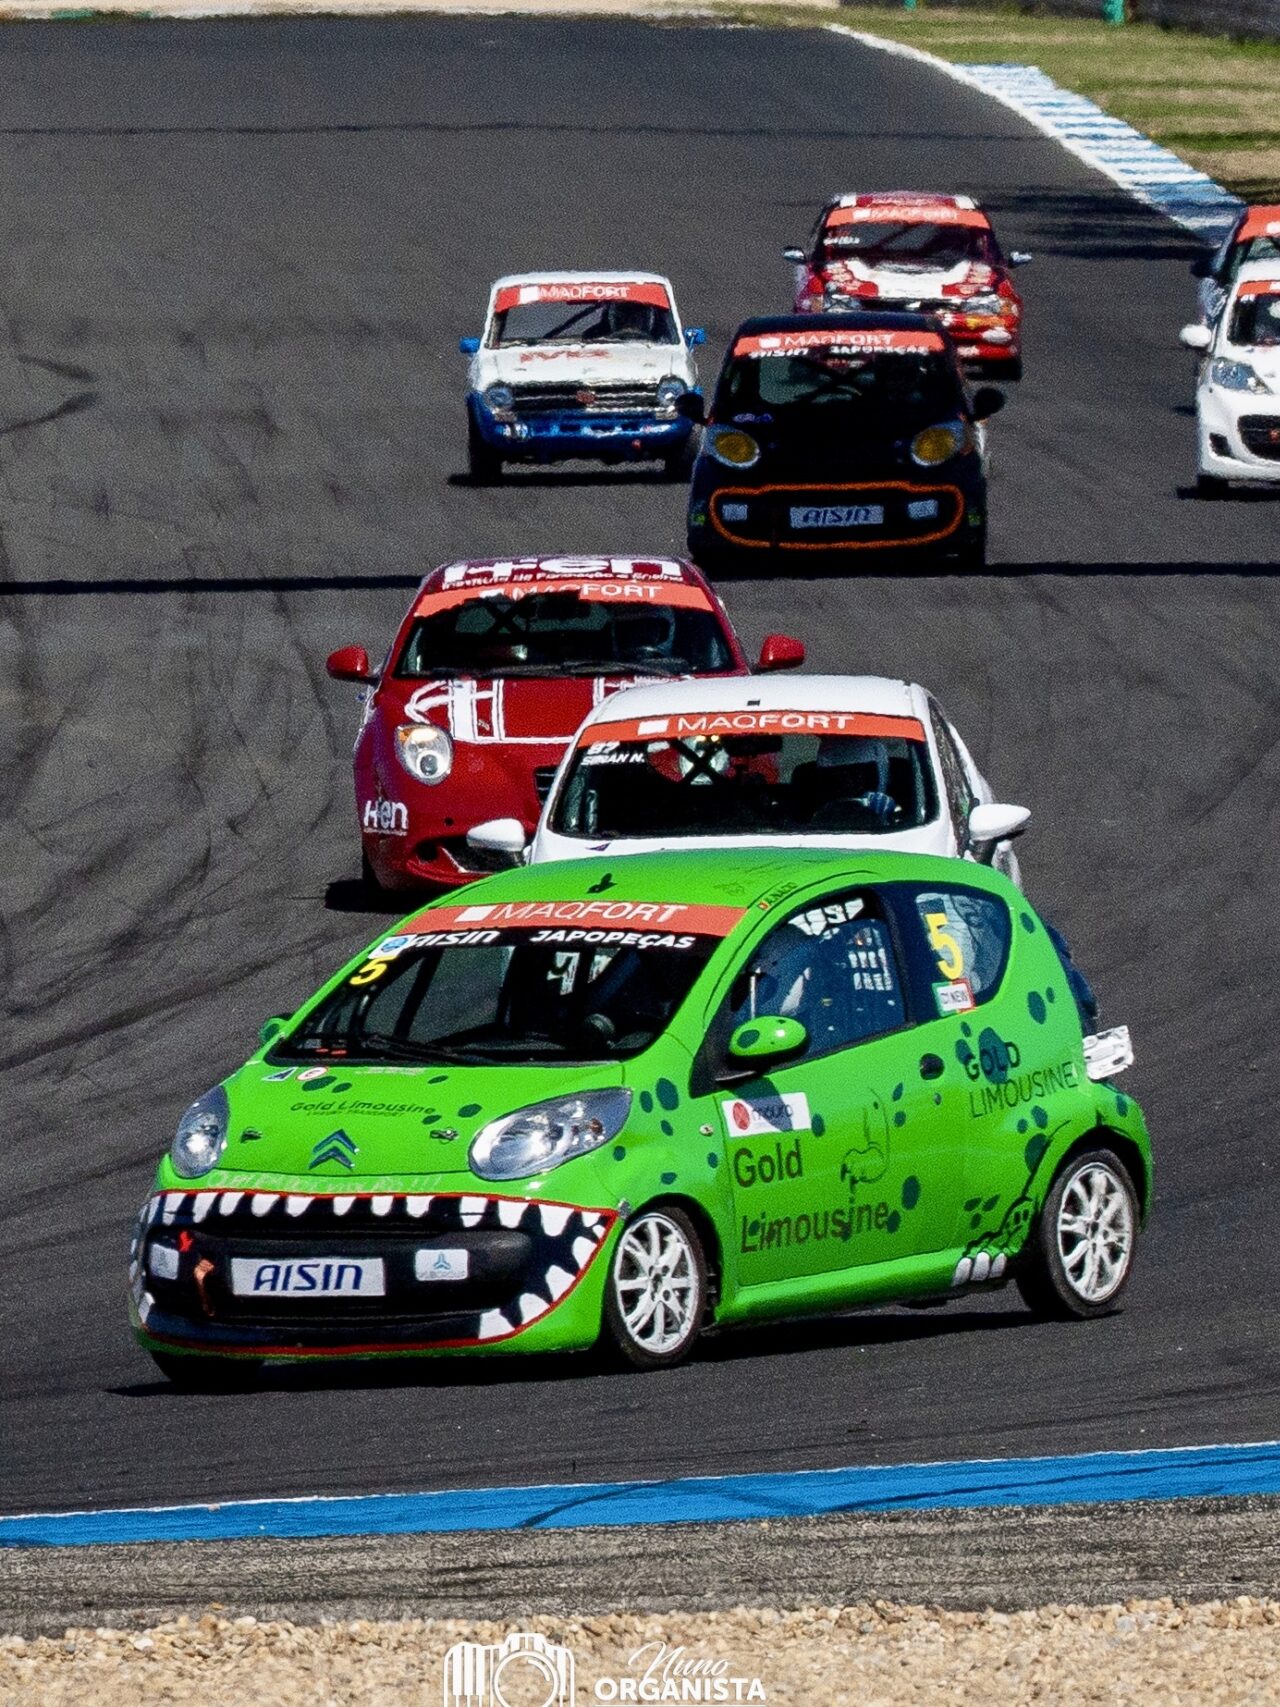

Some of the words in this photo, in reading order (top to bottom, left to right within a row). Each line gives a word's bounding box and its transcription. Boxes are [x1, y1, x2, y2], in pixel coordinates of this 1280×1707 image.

[539, 285, 631, 300] MAQFORT
[677, 714, 855, 731] MAQFORT
[494, 902, 689, 922] MAQFORT
[407, 930, 500, 947] AISIN
[528, 930, 697, 950] JAPOPEÇAS
[925, 912, 964, 980] 5
[349, 957, 397, 986] 5
[964, 1041, 1021, 1083] GOLD
[968, 1060, 1079, 1119] LIMOUSINE
[290, 1101, 336, 1112] Gold
[337, 1100, 437, 1115] Limousine
[733, 1138, 804, 1188] Gold
[740, 1201, 891, 1254] Limousine
[253, 1263, 363, 1292] AISIN
